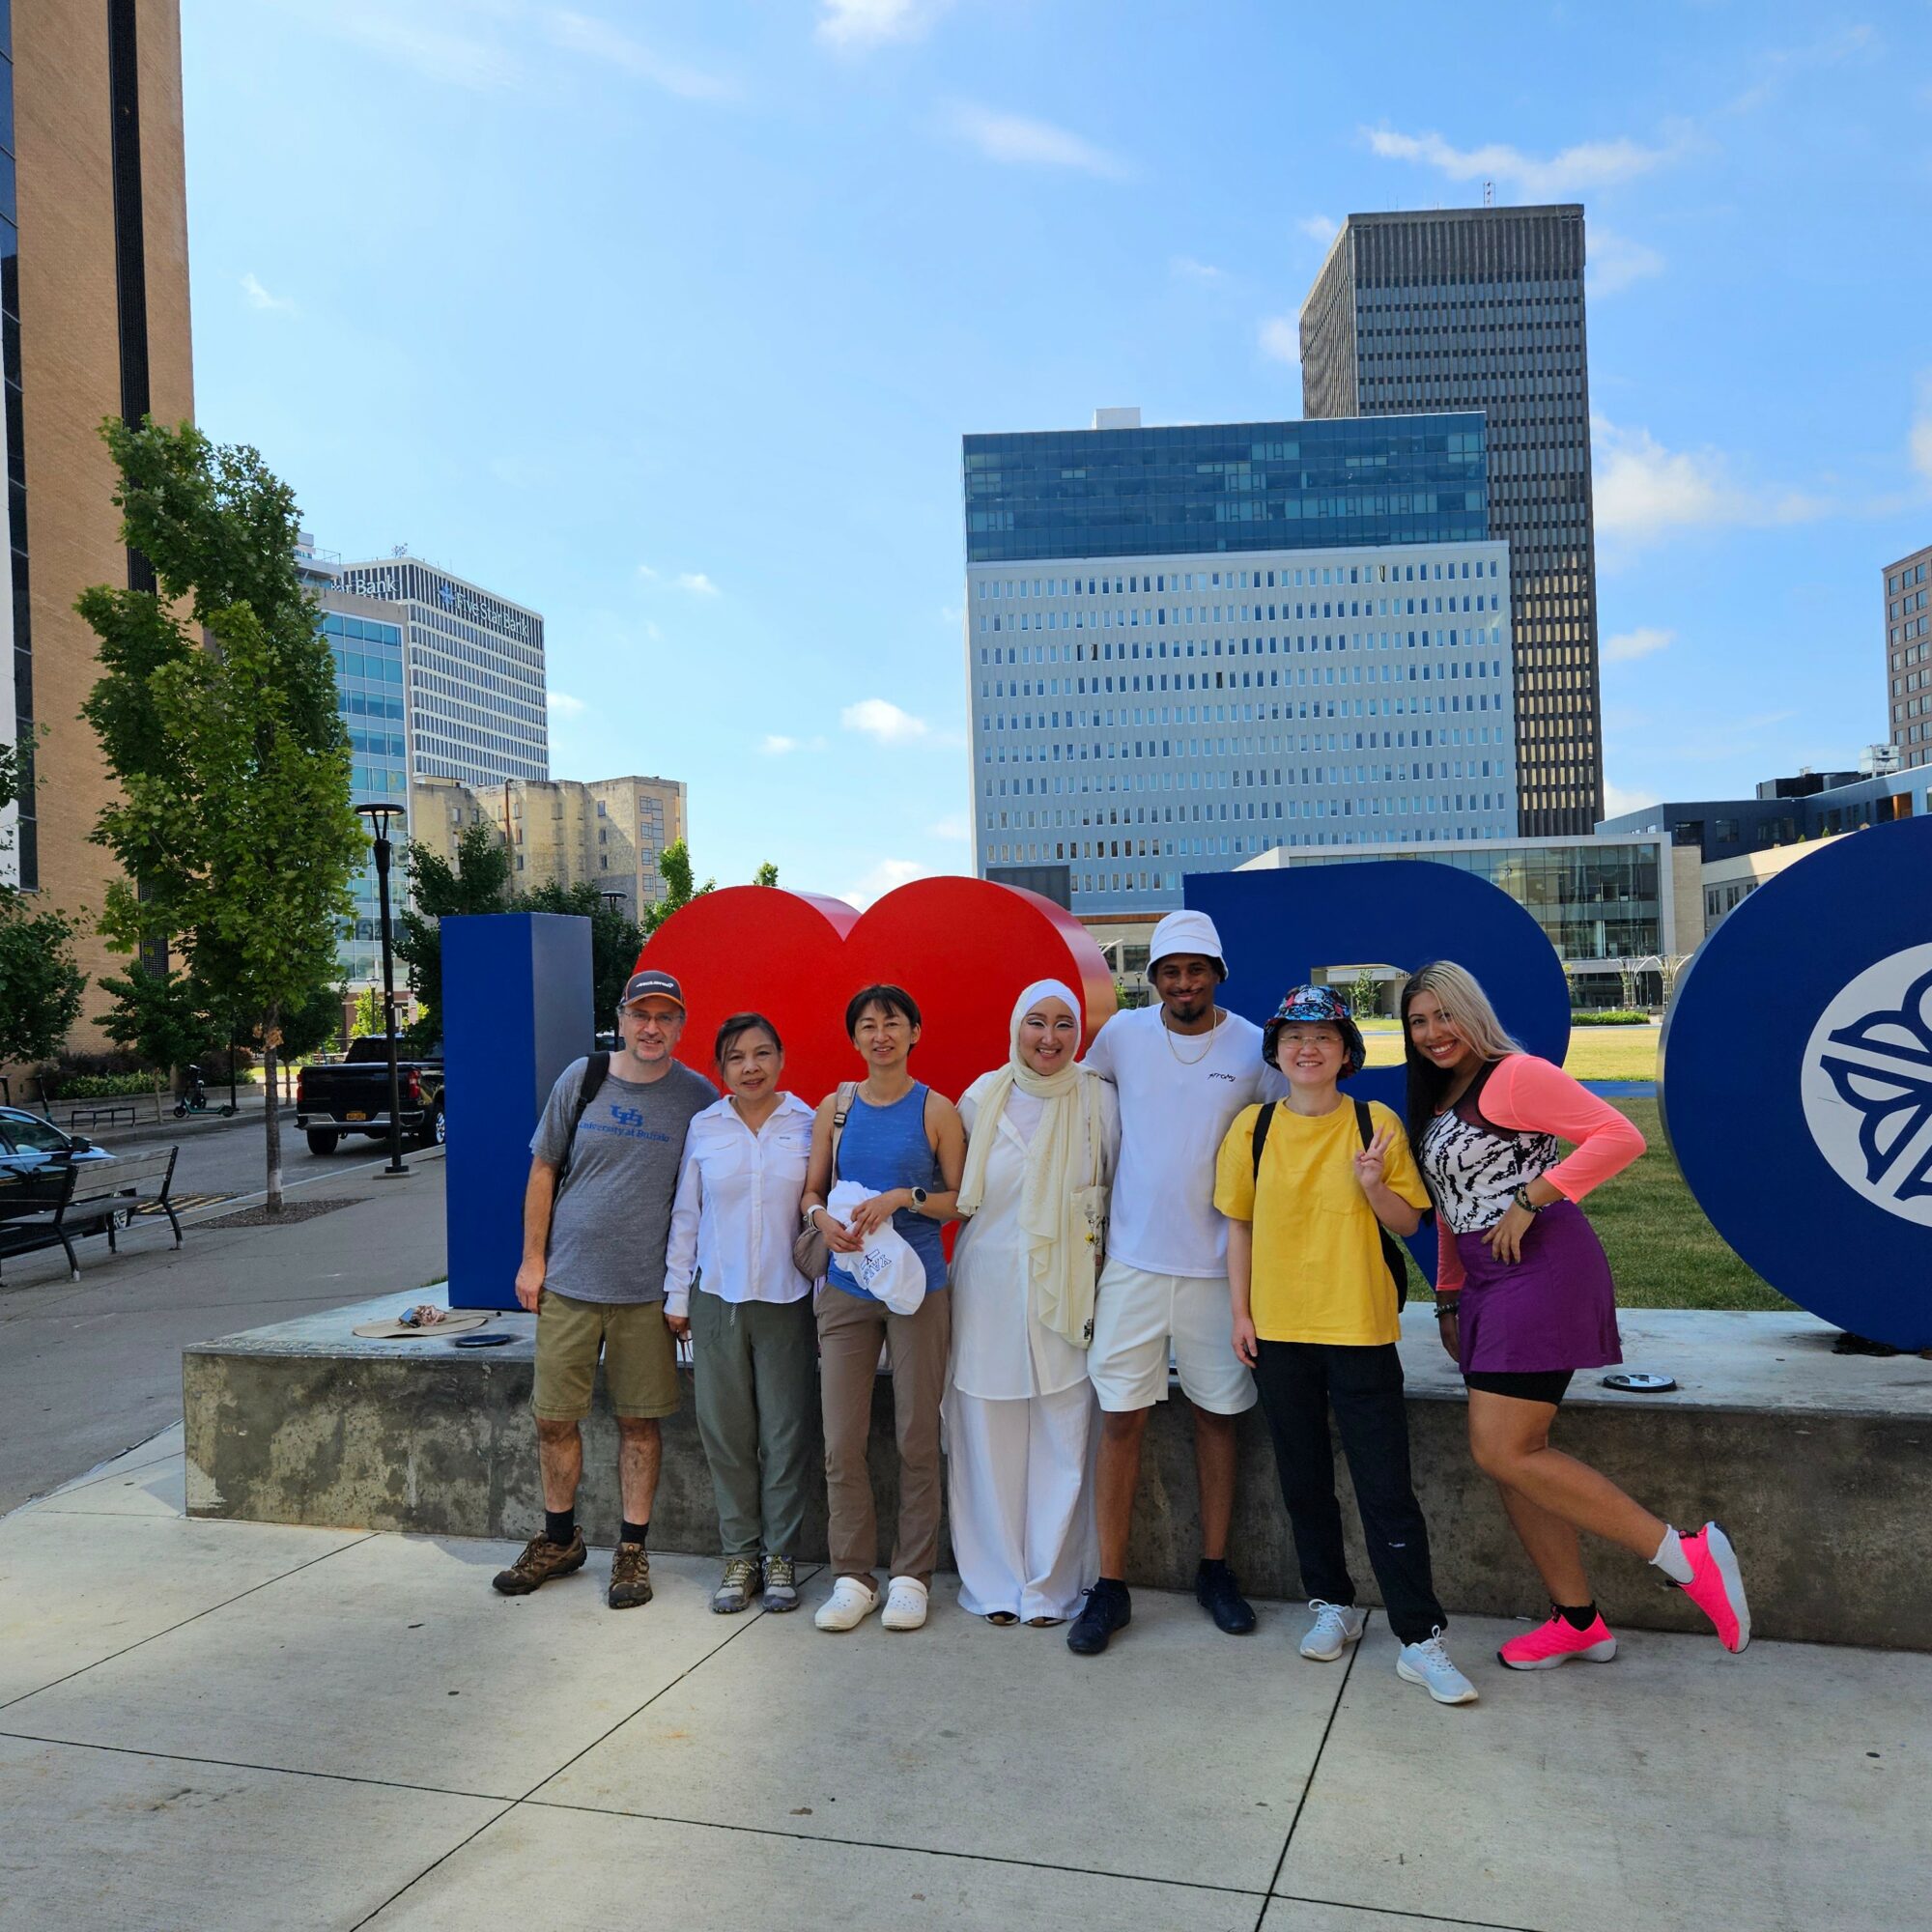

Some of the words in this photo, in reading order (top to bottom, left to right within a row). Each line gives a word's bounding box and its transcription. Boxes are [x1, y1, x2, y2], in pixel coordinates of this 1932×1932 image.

[355, 574, 398, 595] Bank
[456, 592, 480, 616] Five
[480, 603, 502, 626] Star
[503, 612, 528, 638] Bank
[626, 1127, 635, 1137] at
[637, 1129, 670, 1143] Buffalo
